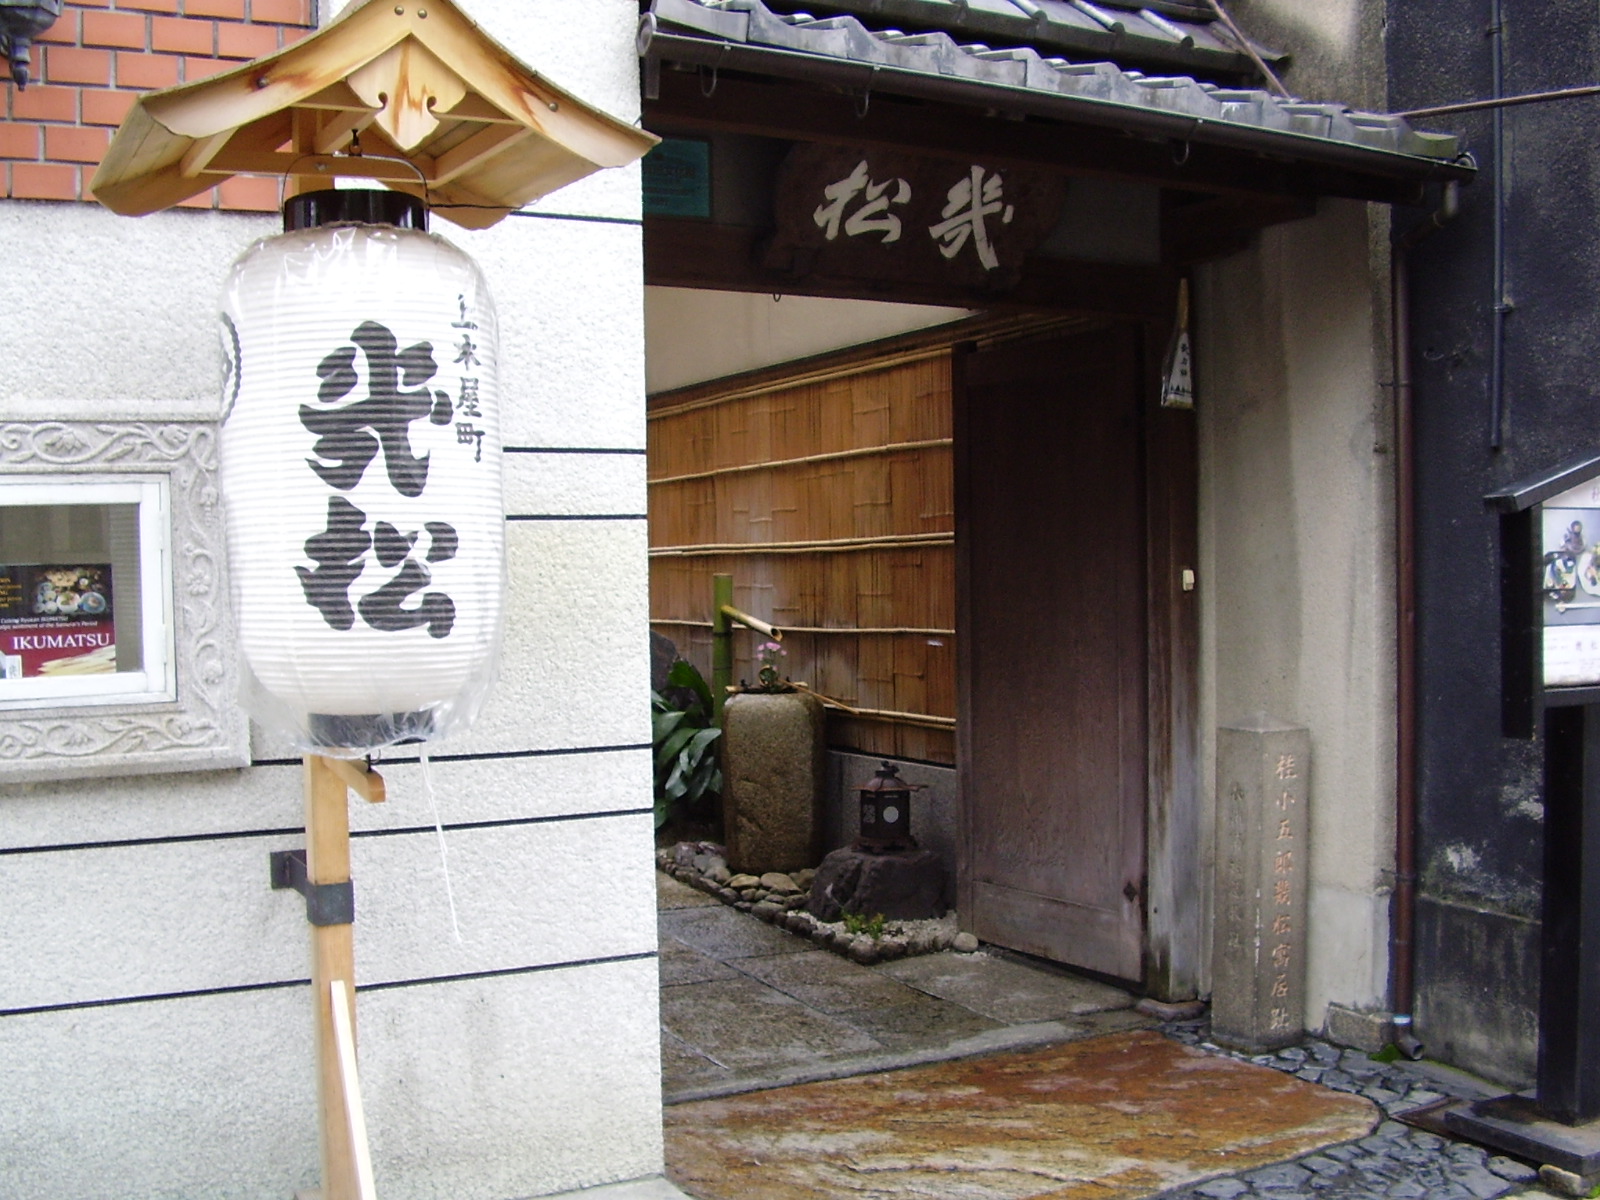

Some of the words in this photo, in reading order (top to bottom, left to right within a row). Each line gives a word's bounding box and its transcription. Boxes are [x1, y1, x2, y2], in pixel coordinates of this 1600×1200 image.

[450, 293, 486, 463] 上木屋町
[13, 632, 110, 651] IKUMATSU
